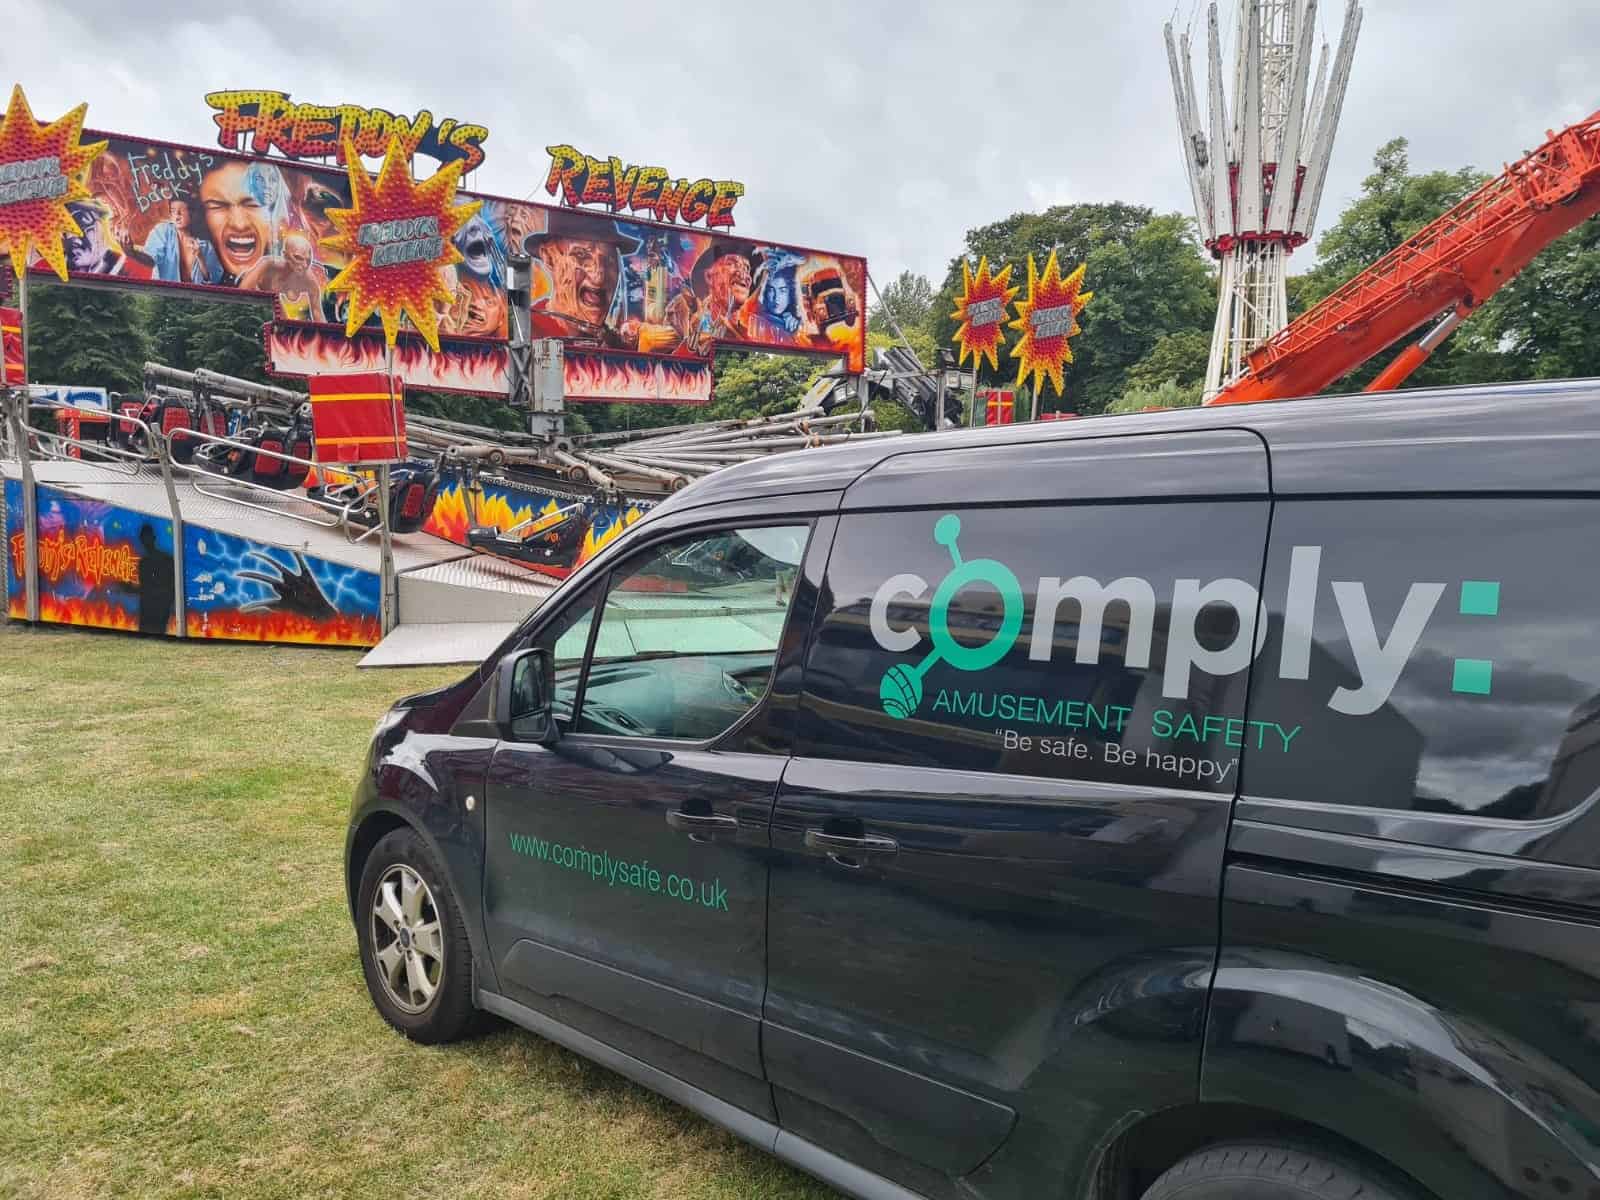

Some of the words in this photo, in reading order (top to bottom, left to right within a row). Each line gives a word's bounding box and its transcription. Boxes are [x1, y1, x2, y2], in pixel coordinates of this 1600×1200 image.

[127, 150, 214, 189] Freddy's
[205, 89, 489, 174] FREDDY'S
[545, 144, 744, 227] REVENGE
[132, 180, 190, 213] back
[932, 689, 1132, 732] AMUSEMENT
[1152, 710, 1302, 752] SAFETY
[1039, 737, 1094, 760] safe.
[1104, 742, 1137, 766] Be
[510, 832, 729, 911] www.complysafe.co.uk
